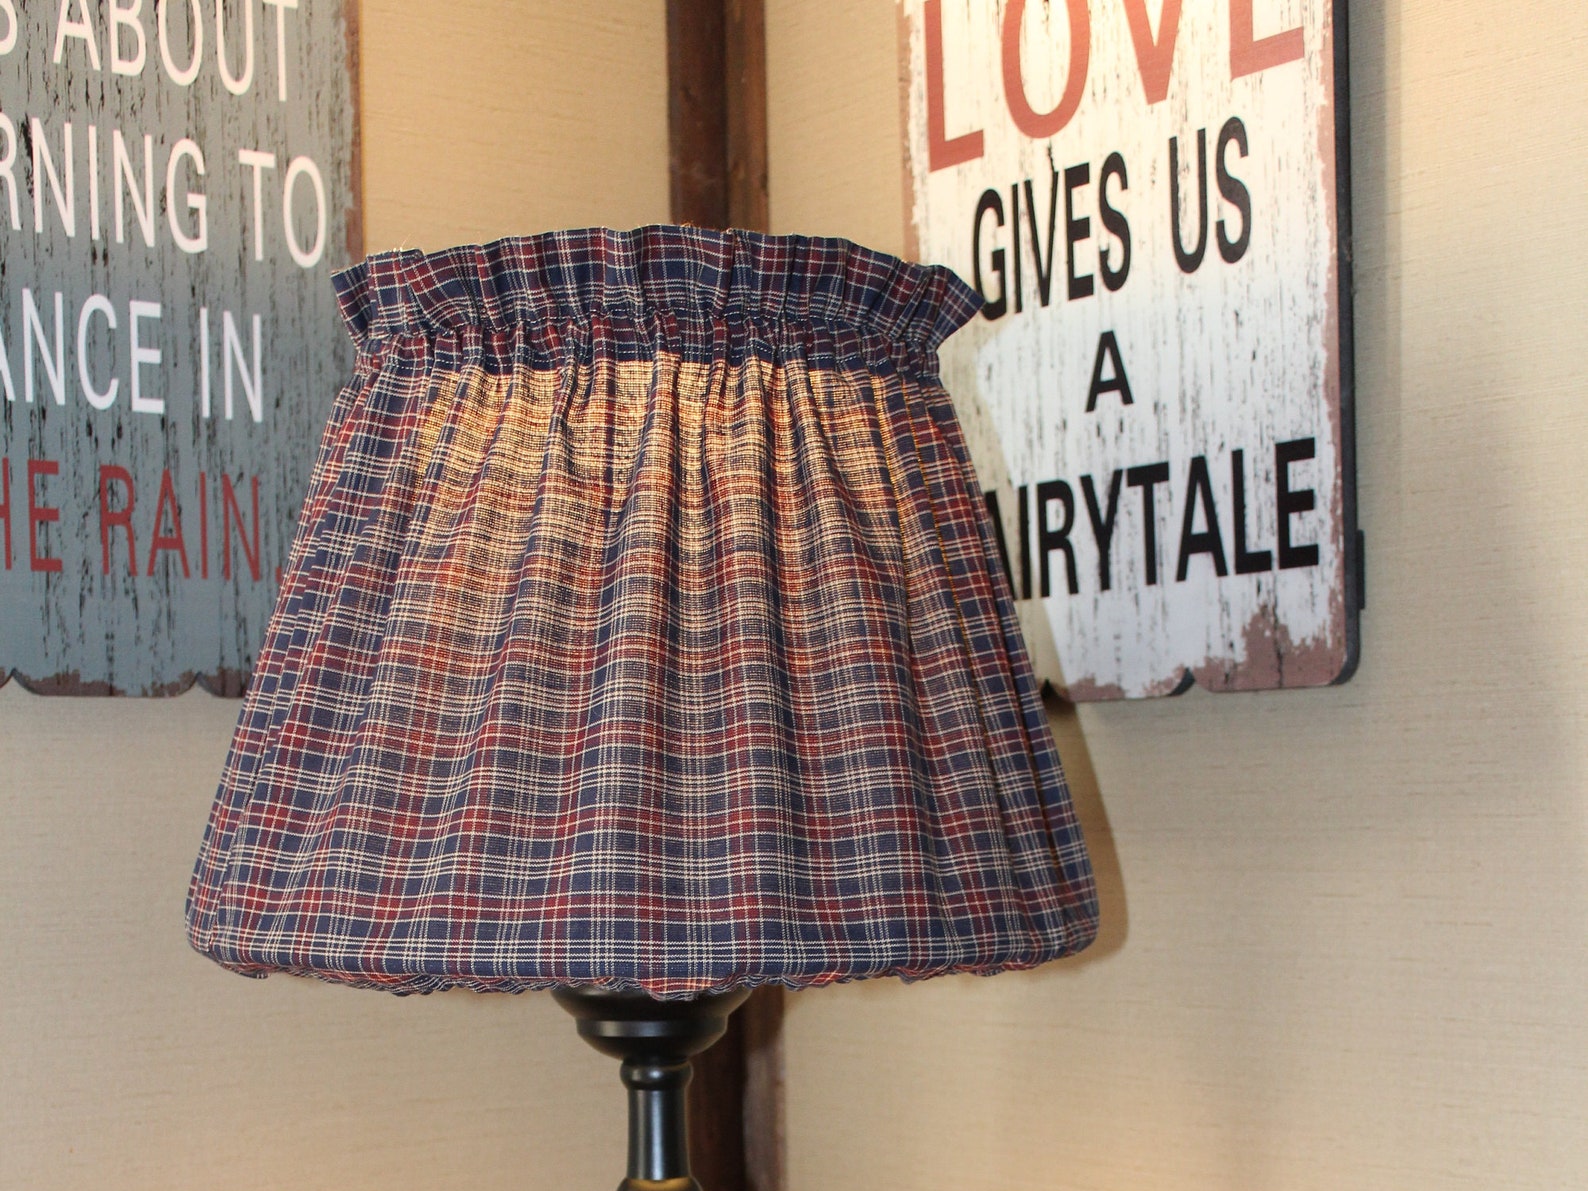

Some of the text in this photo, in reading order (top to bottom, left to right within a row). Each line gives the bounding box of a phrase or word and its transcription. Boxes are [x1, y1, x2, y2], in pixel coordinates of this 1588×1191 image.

[53, 0, 298, 102] ABOUT
[238, 148, 327, 269] TO
[973, 116, 1252, 321] GIVES US
[200, 305, 264, 423] IN
[1085, 330, 1134, 412] A
